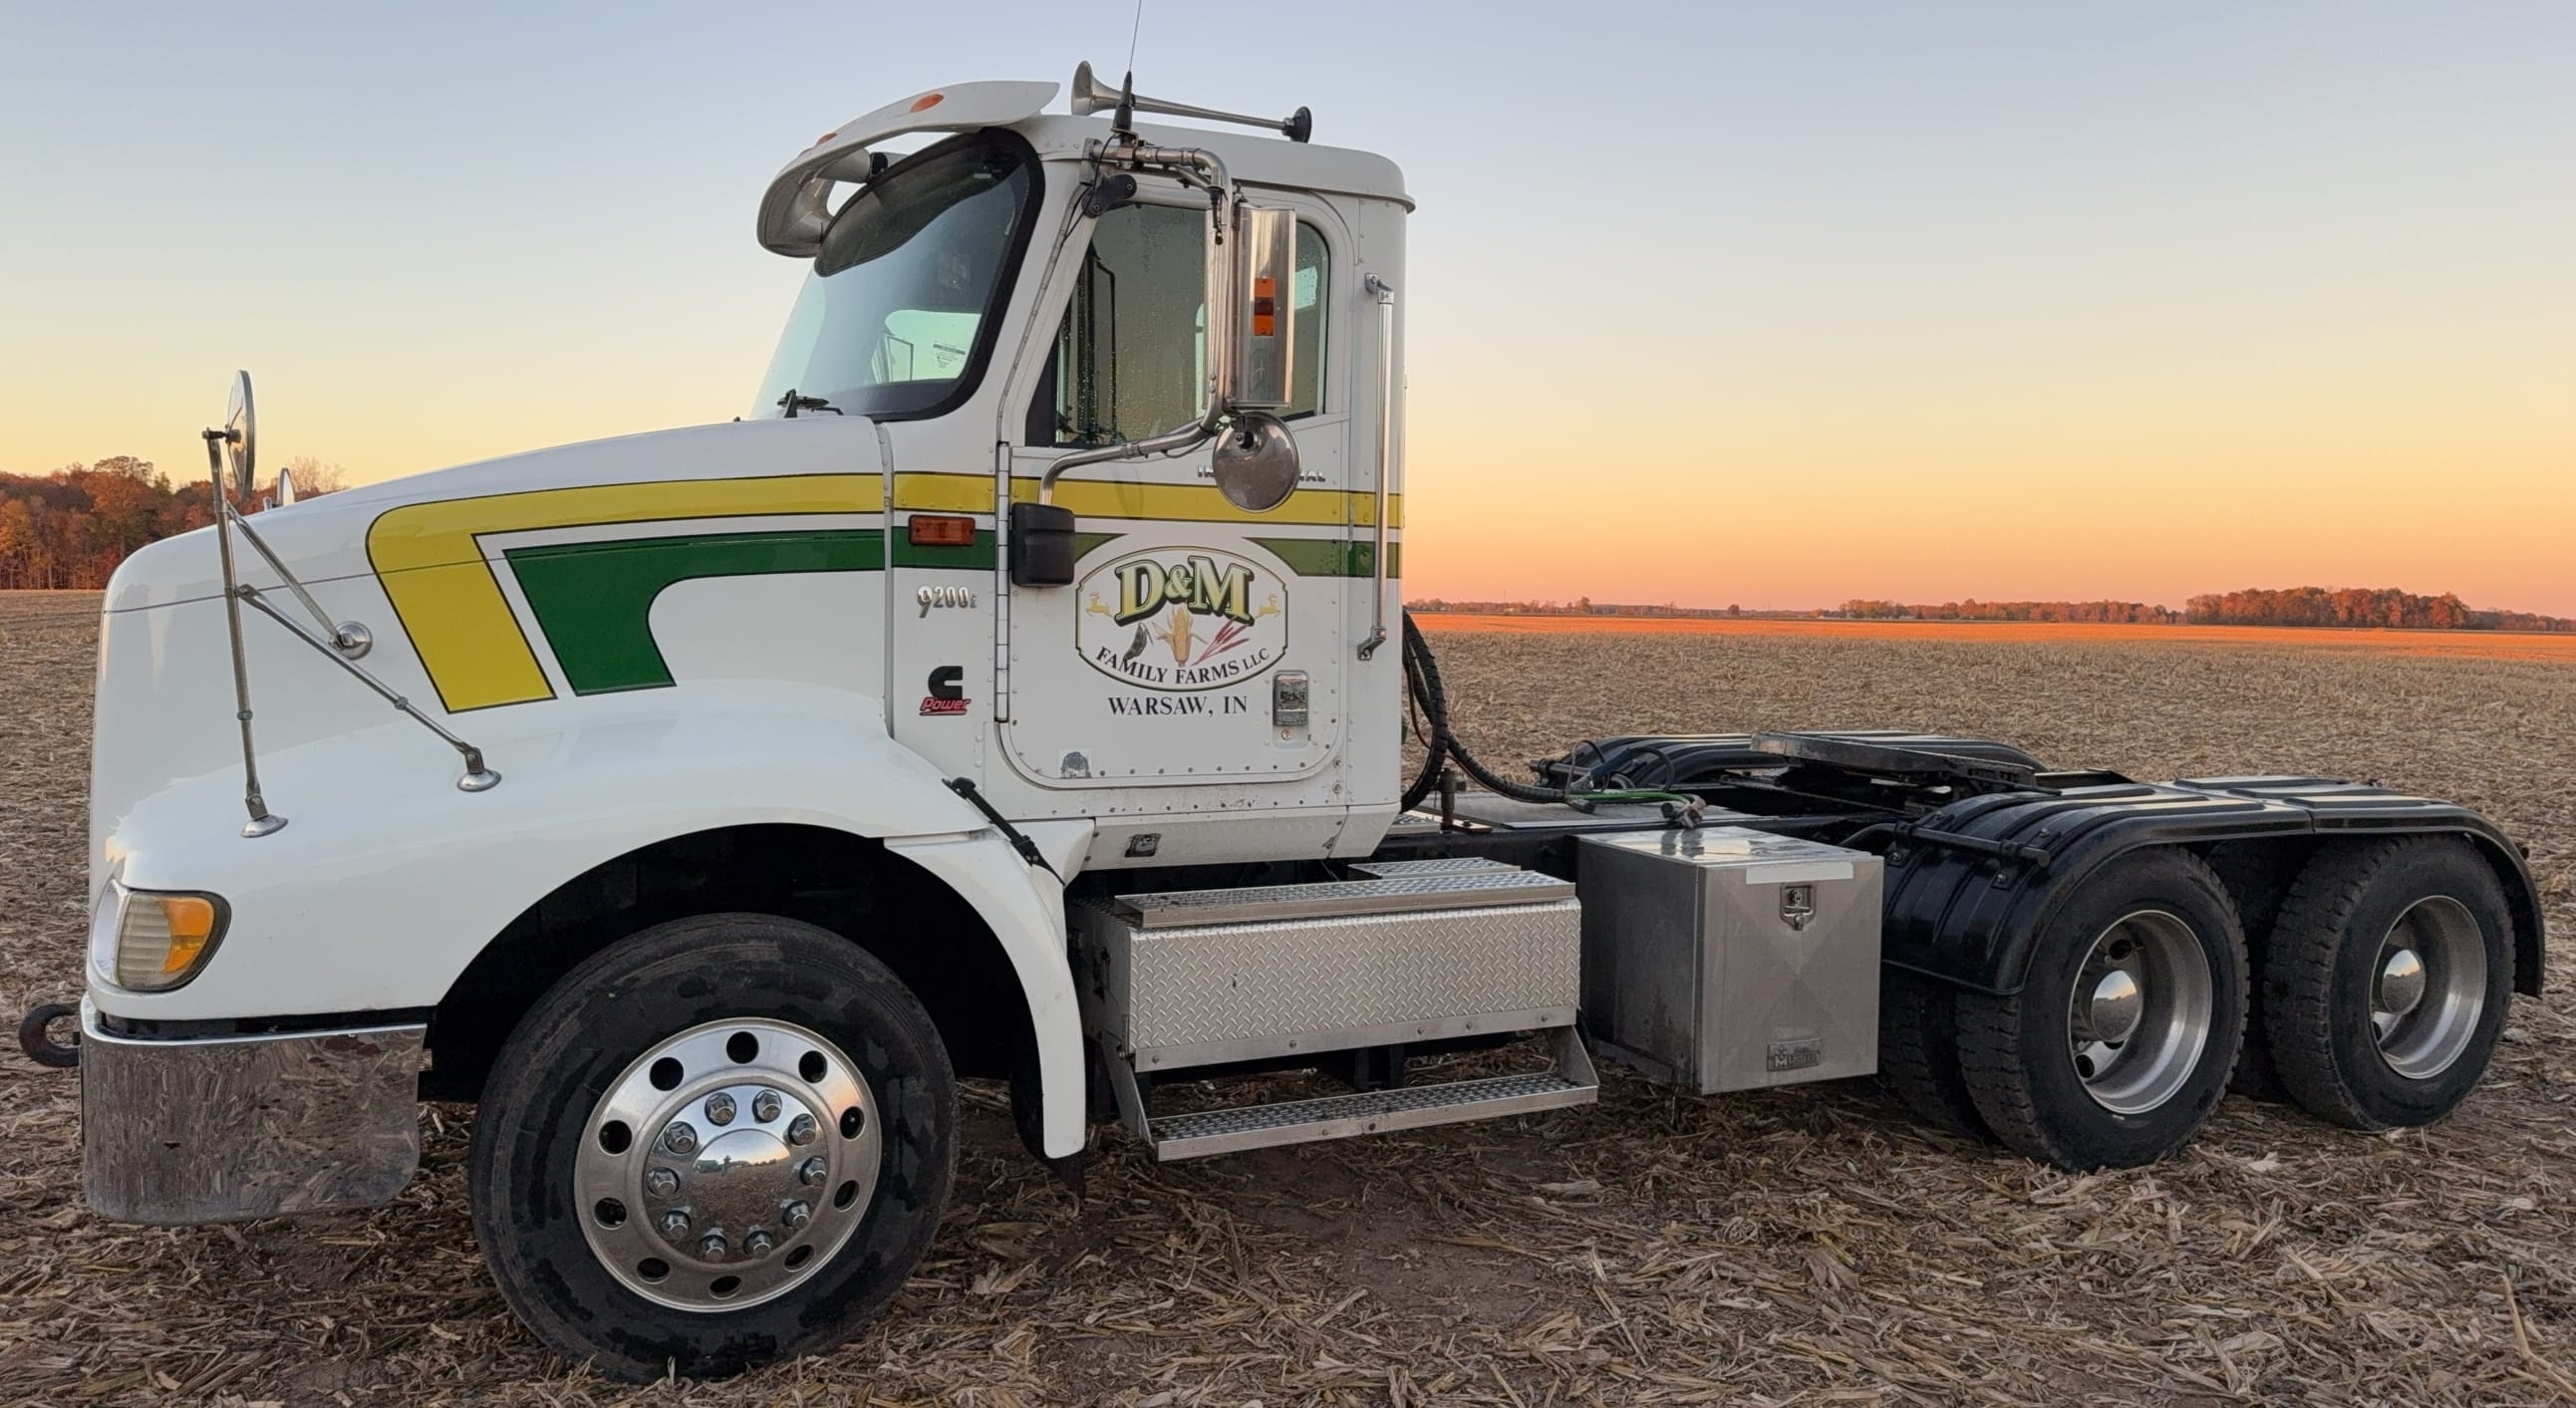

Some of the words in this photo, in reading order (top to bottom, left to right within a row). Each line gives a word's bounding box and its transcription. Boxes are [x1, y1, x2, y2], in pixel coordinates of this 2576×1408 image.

[1114, 555, 1255, 627] D&M
[1095, 647, 1168, 684] FAMILY
[1175, 659, 1240, 685] FARMS
[1243, 648, 1271, 671] LLC
[920, 697, 972, 712] Power
[1108, 697, 1214, 717] WARSAW,
[1224, 696, 1248, 714] IN
